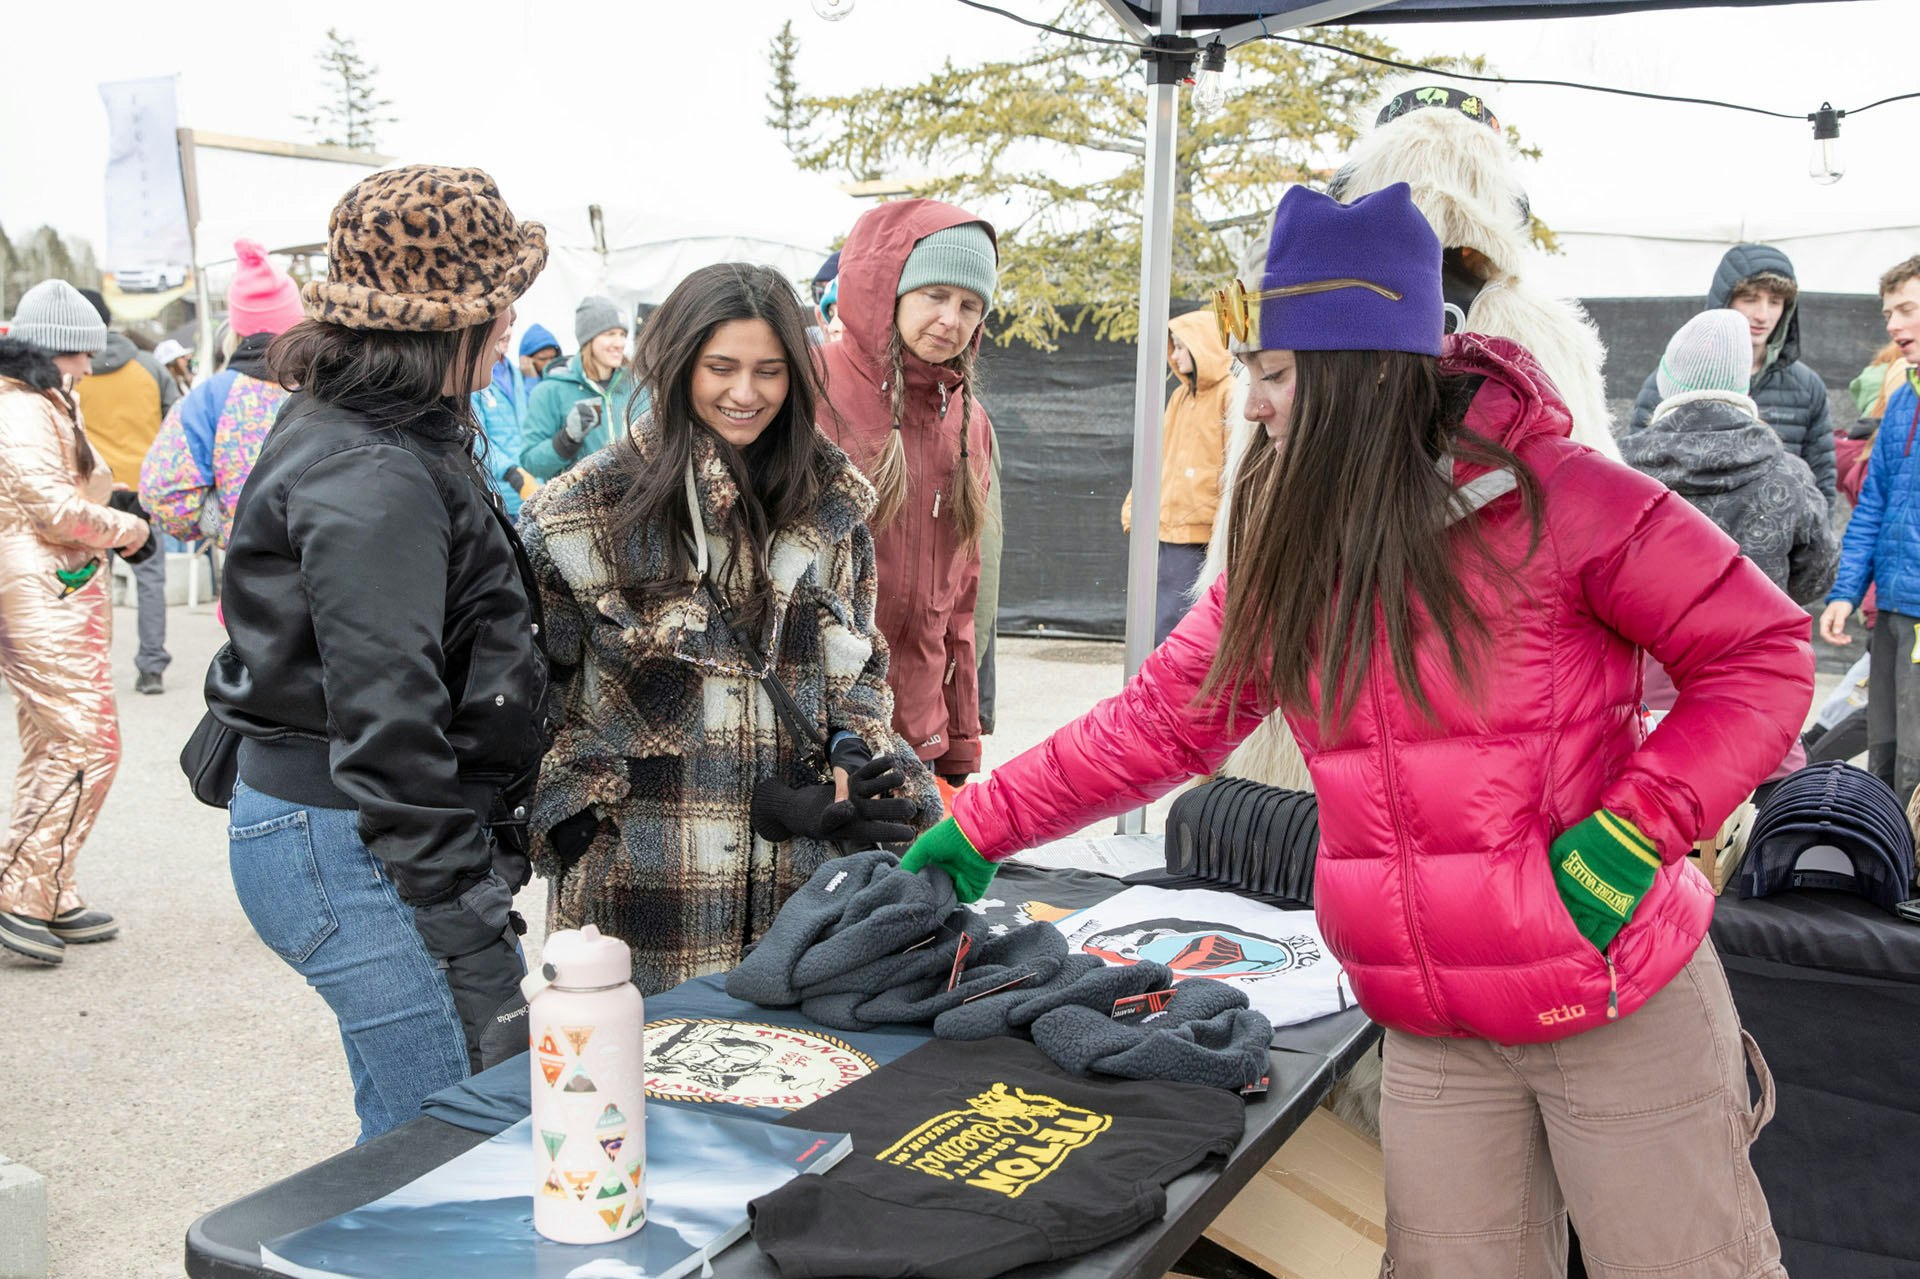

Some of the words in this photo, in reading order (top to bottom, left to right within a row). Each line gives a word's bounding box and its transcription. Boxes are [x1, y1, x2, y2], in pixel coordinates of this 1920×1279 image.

[1594, 883, 1633, 912] NATURE
[496, 1004, 530, 1024] Columbia
[1538, 1004, 1586, 1026] stio
[953, 1136, 1017, 1177] GRAVITY
[966, 1114, 1105, 1194] TETON
